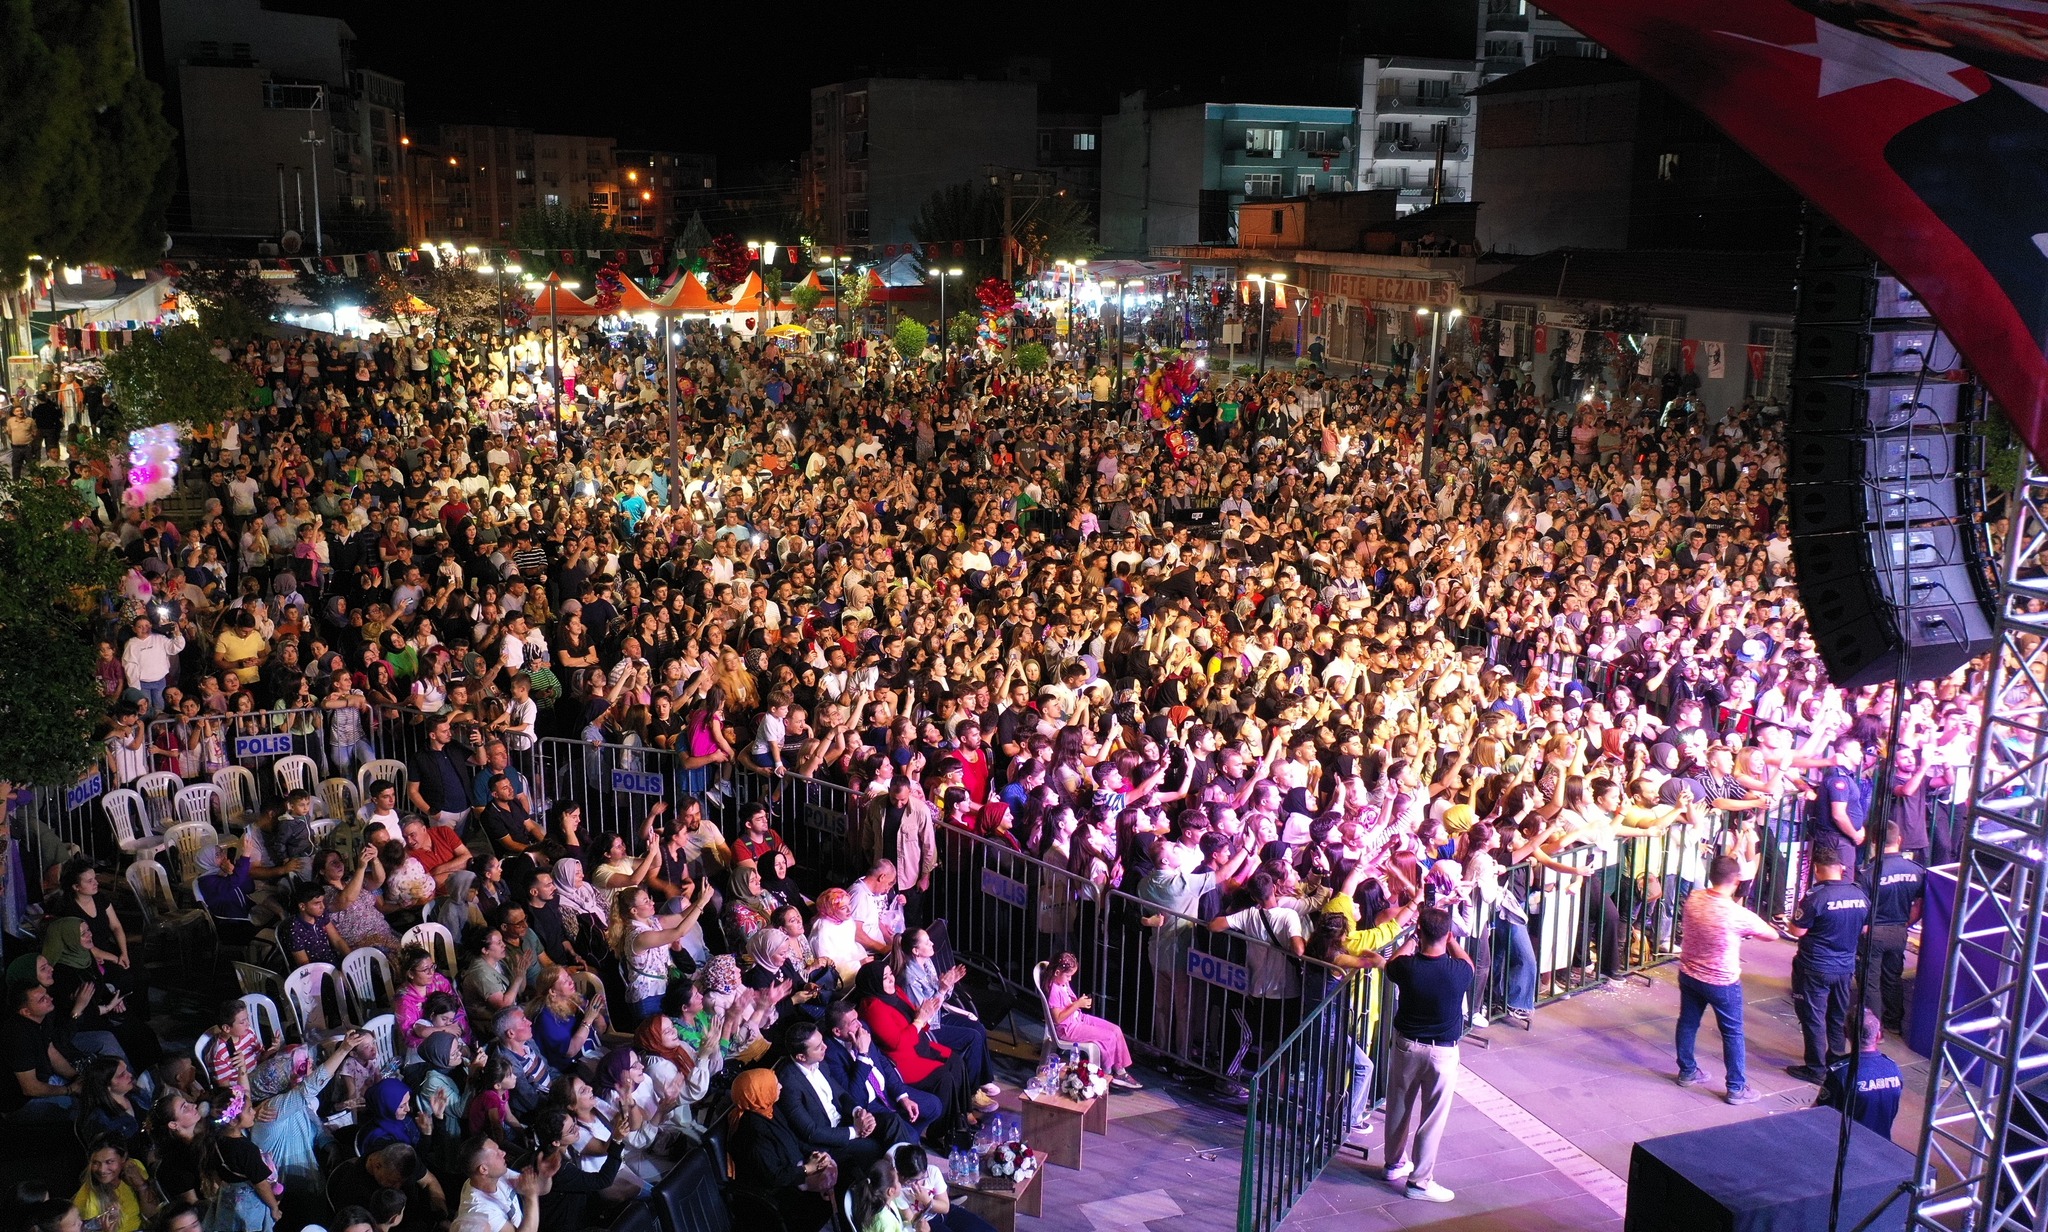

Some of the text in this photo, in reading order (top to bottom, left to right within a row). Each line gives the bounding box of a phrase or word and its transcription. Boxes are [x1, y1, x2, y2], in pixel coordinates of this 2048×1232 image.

[1331, 275, 1366, 299] METE
[1880, 874, 1917, 885] ZABITA
[1827, 899, 1866, 910] ZABITA
[1857, 1076, 1901, 1092] ZABITA
